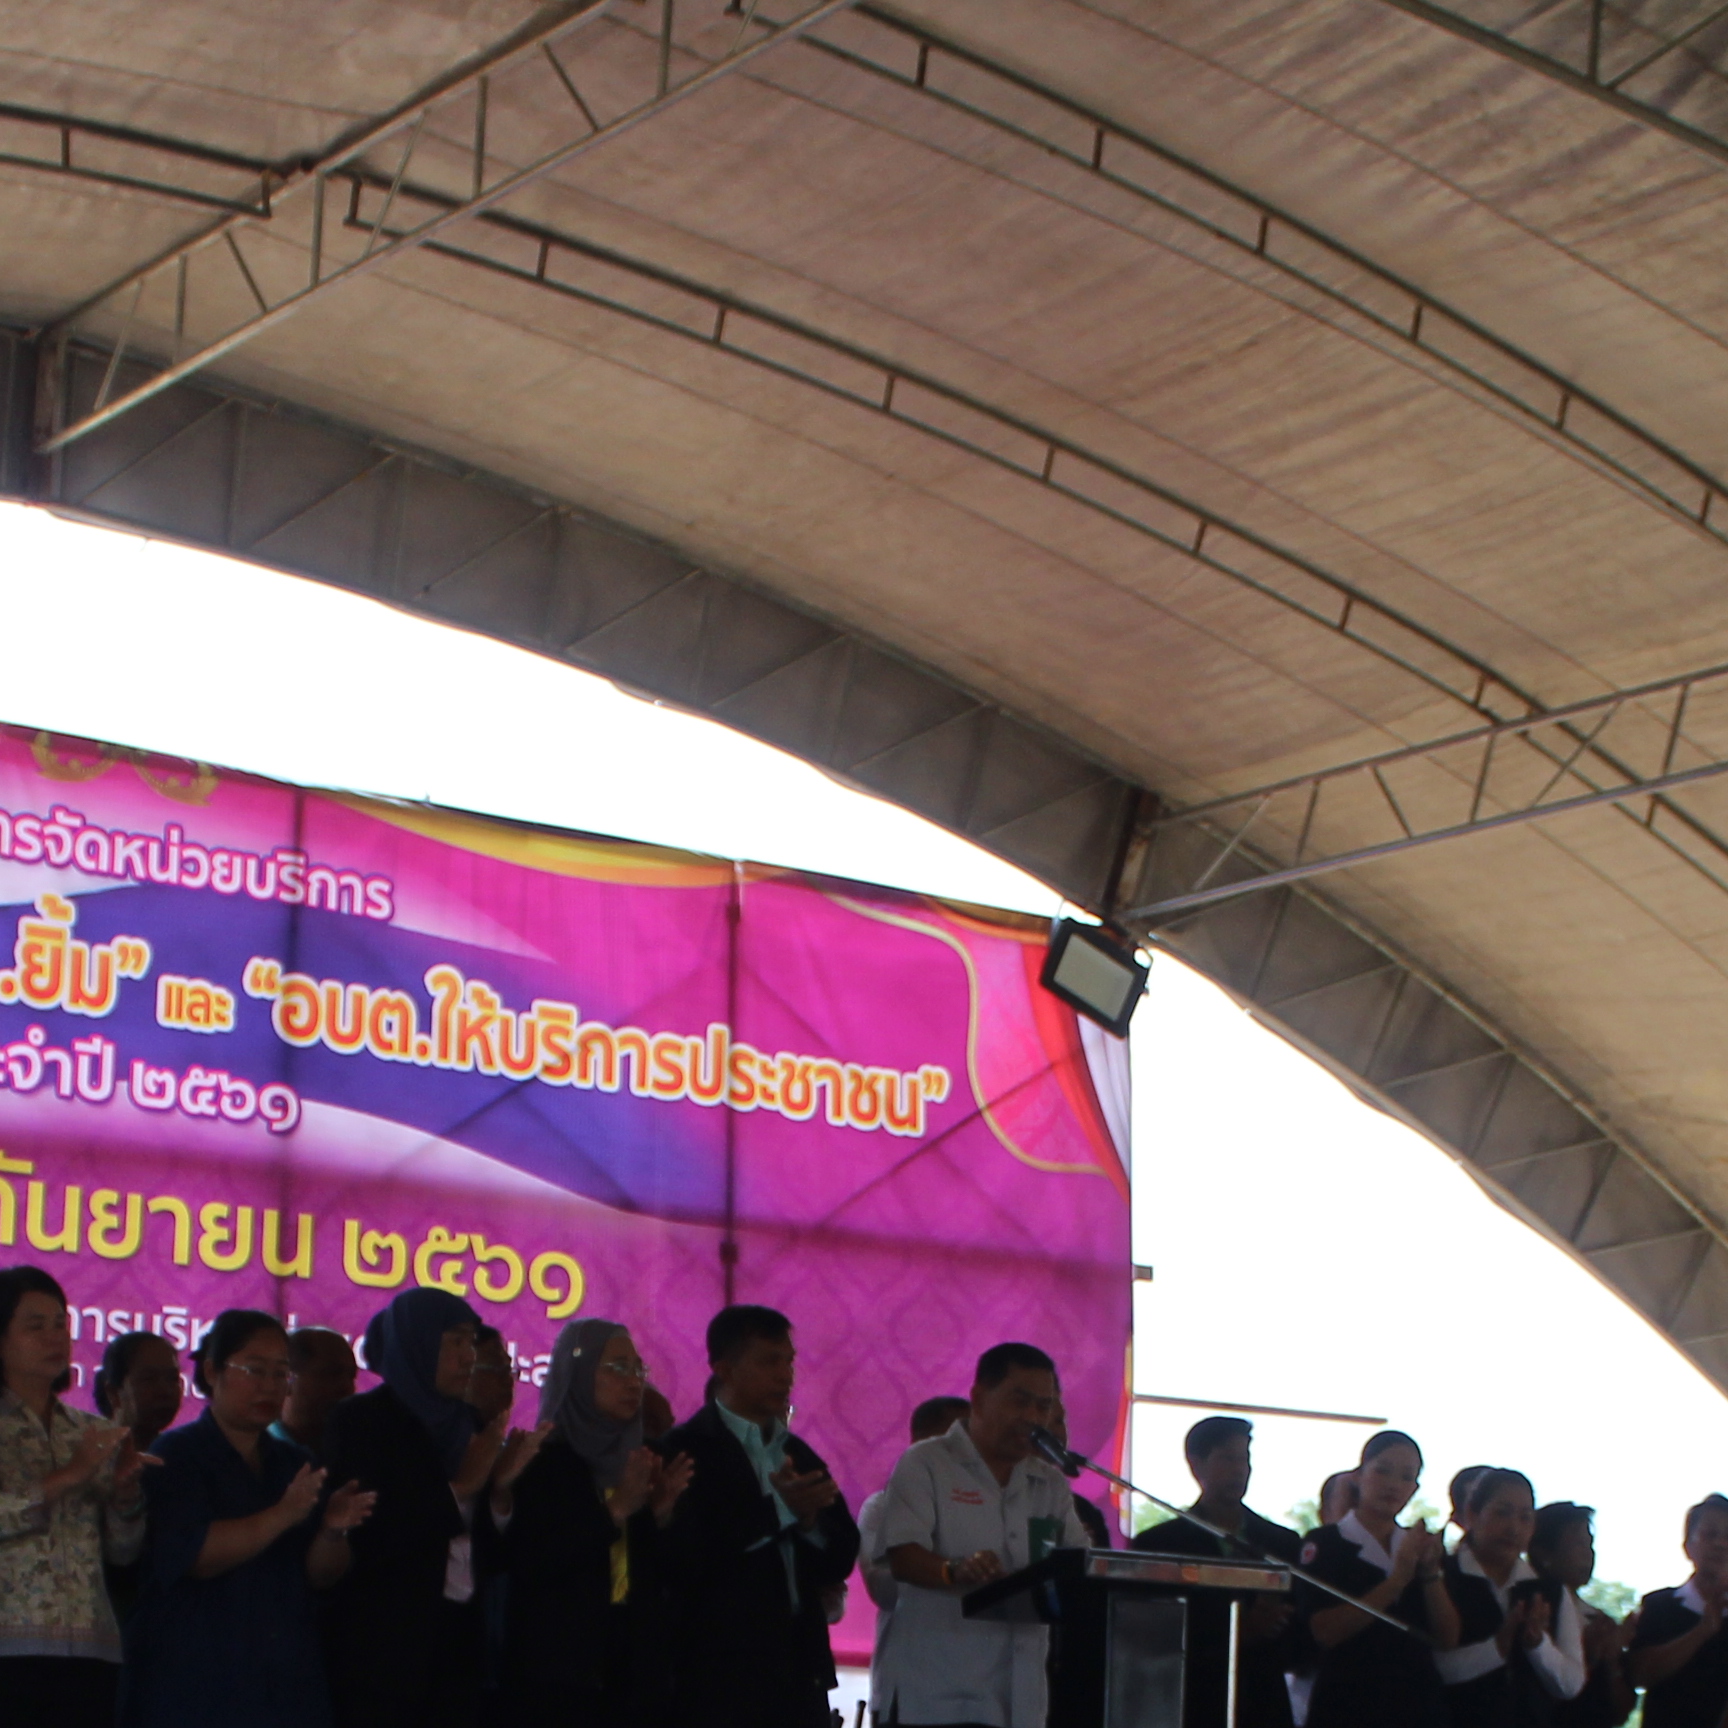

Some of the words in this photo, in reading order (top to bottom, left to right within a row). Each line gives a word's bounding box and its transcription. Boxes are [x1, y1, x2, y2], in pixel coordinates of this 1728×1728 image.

[161, 974, 233, 1032] และ
[131, 1062, 300, 1133] ๒๕๖๑
[341, 1198, 585, 1319] ๒๕๖๑
